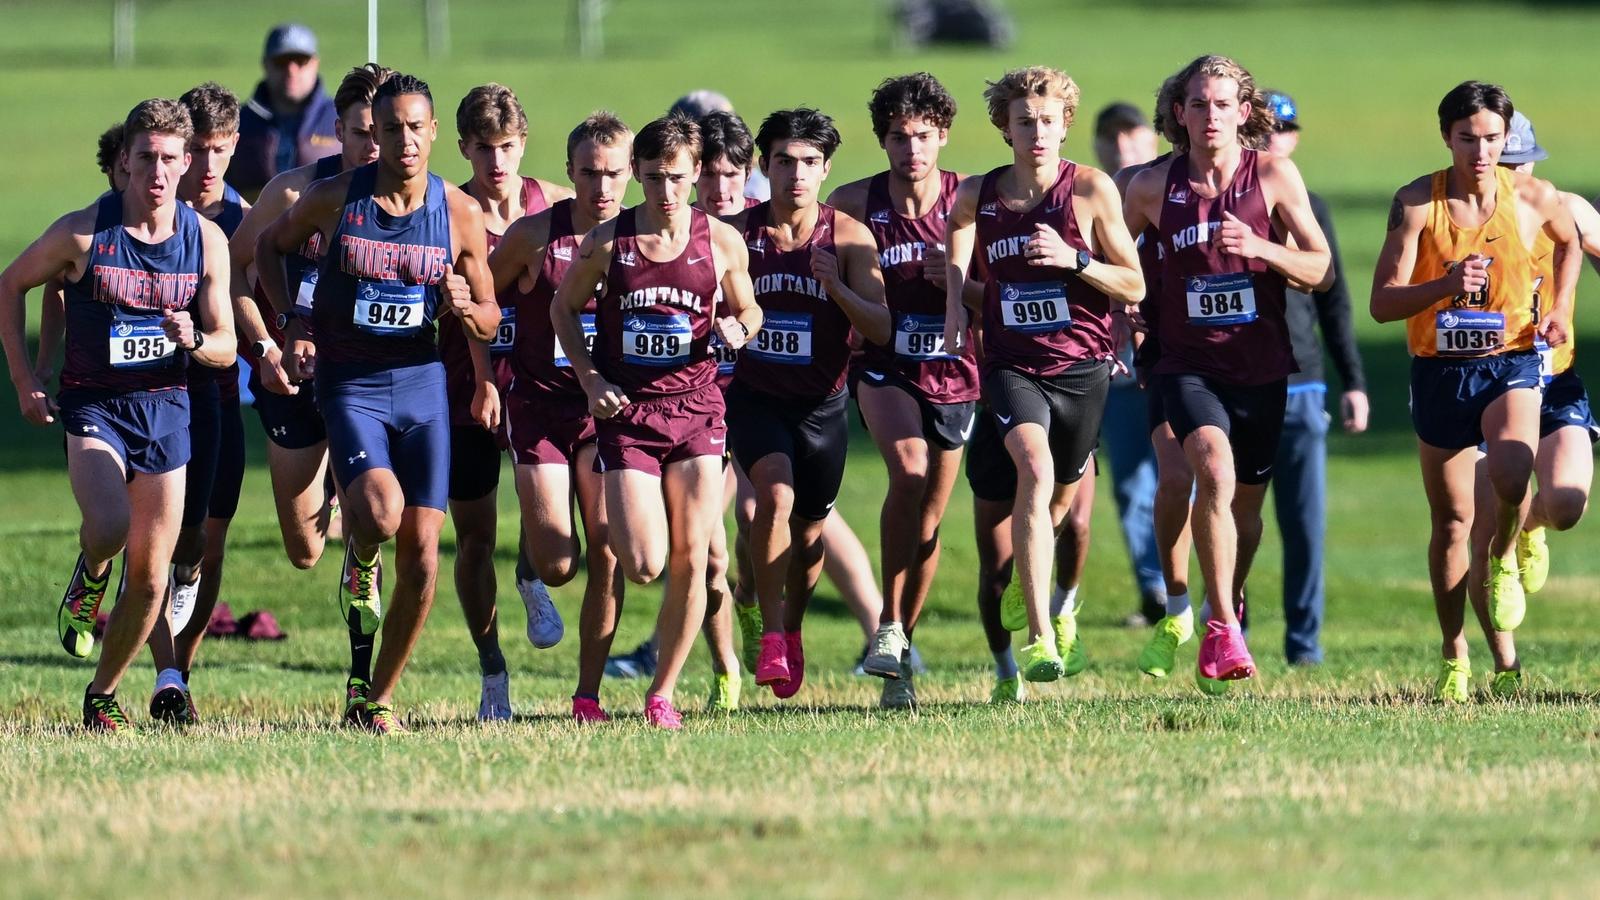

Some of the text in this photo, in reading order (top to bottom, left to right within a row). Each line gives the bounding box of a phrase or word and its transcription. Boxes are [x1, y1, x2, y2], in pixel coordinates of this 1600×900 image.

[986, 235, 1031, 264] MONT
[1172, 222, 1220, 253] MONT
[340, 234, 446, 285] THUNDERWOLVES
[93, 265, 198, 311] THUNDERWOLVES
[620, 287, 702, 314] MONTANA
[1012, 300, 1057, 324] 990
[1200, 292, 1243, 316] 984
[368, 303, 411, 326] 942
[123, 337, 165, 360] 935
[635, 334, 680, 356] 989
[757, 330, 799, 354] 988
[1443, 330, 1499, 349] 1036
